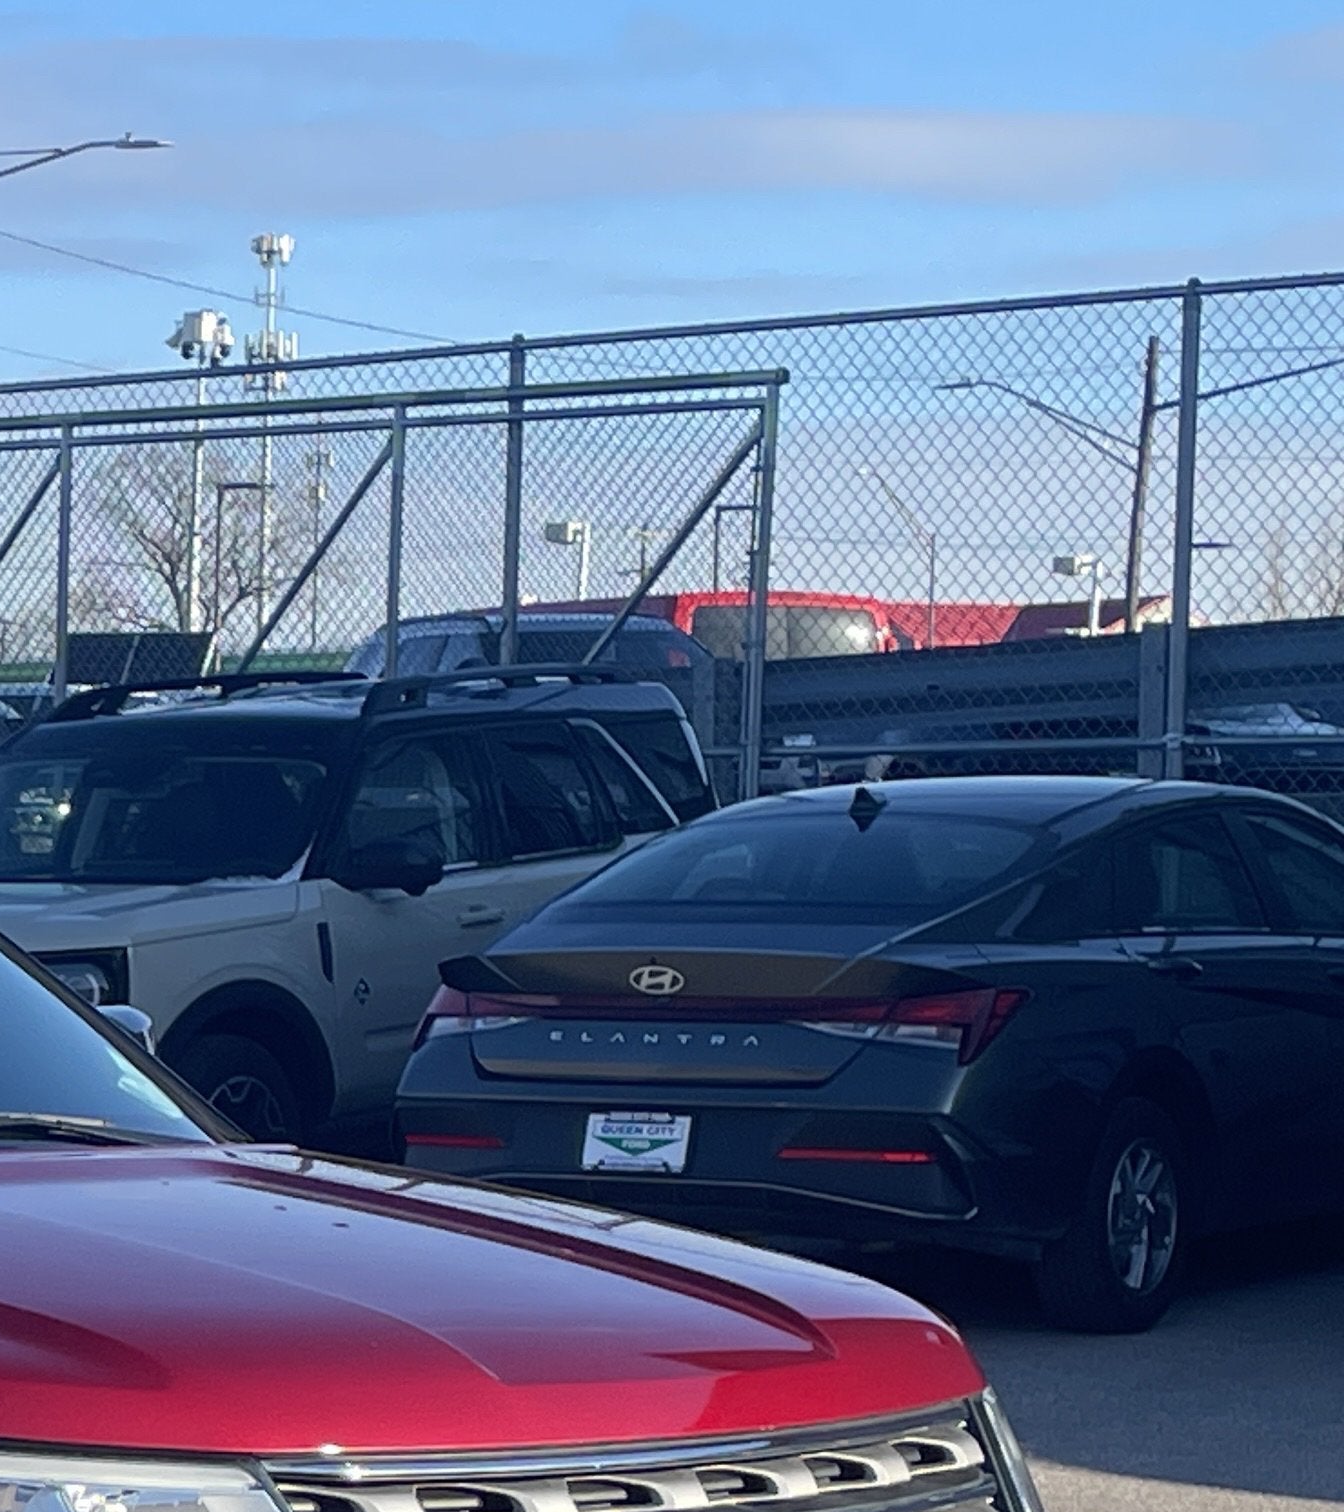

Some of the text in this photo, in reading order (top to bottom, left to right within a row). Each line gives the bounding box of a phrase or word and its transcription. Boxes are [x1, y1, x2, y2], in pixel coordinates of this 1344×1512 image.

[550, 1031, 759, 1046] ELANTRA
[600, 1124, 677, 1137] QUEEN CITY
